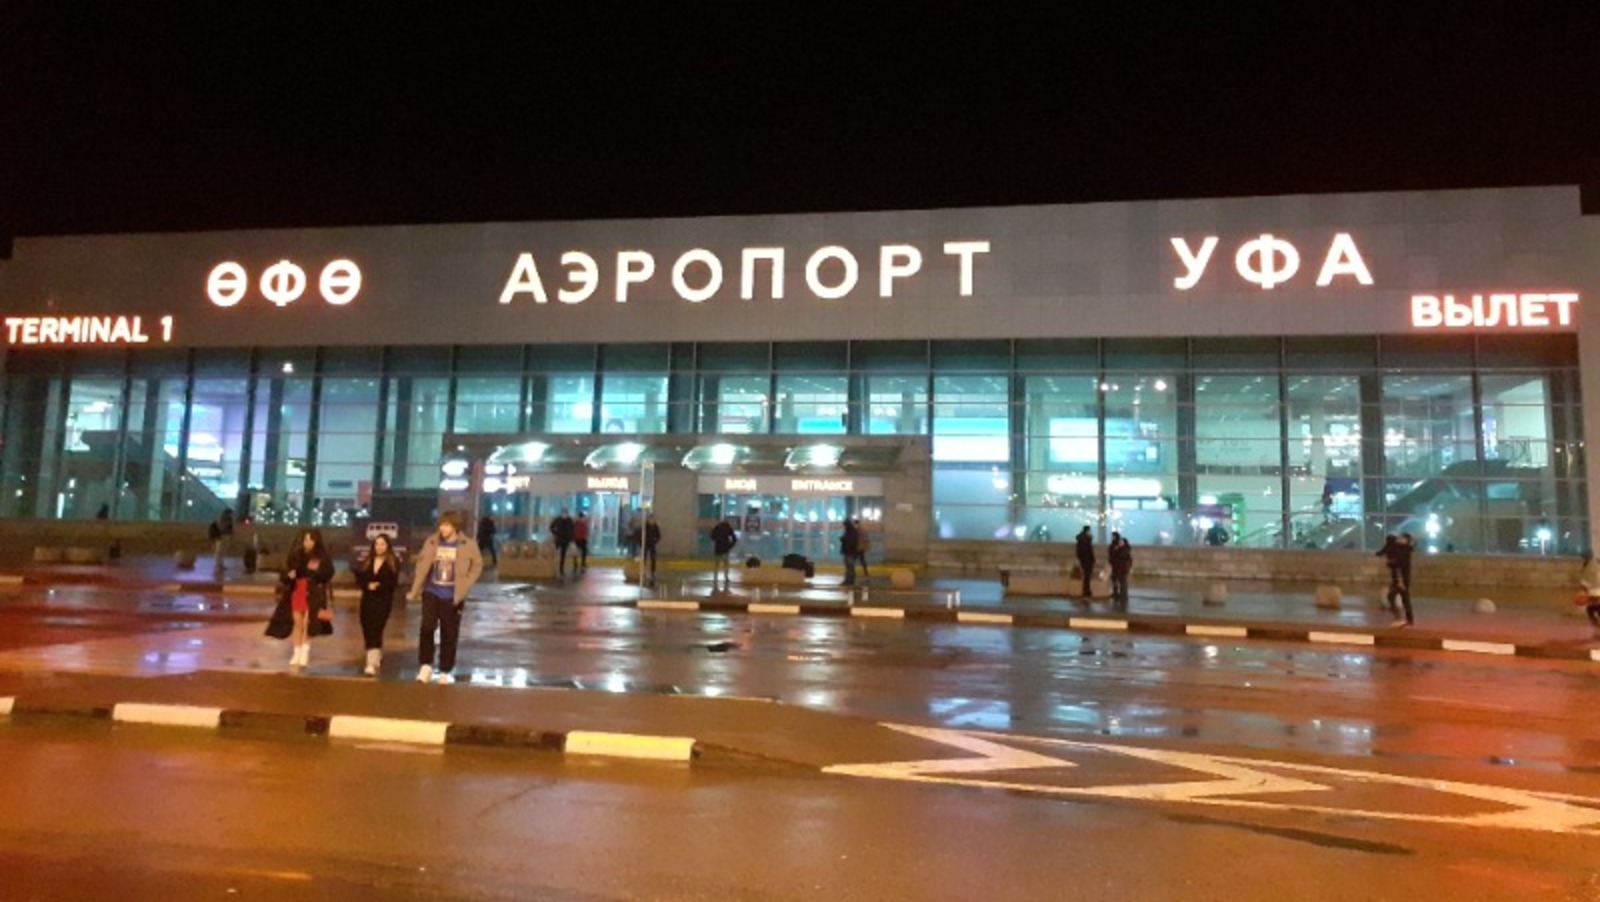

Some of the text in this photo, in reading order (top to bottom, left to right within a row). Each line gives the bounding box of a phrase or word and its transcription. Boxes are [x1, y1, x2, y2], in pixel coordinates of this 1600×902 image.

[498, 240, 991, 305] АЭРОПОРТ
[1169, 231, 1375, 292] УФА
[1409, 291, 1580, 330] ВЫЛЕТ
[4, 314, 173, 345] TERMINAL 1
[791, 479, 853, 491] ENTRANCE
